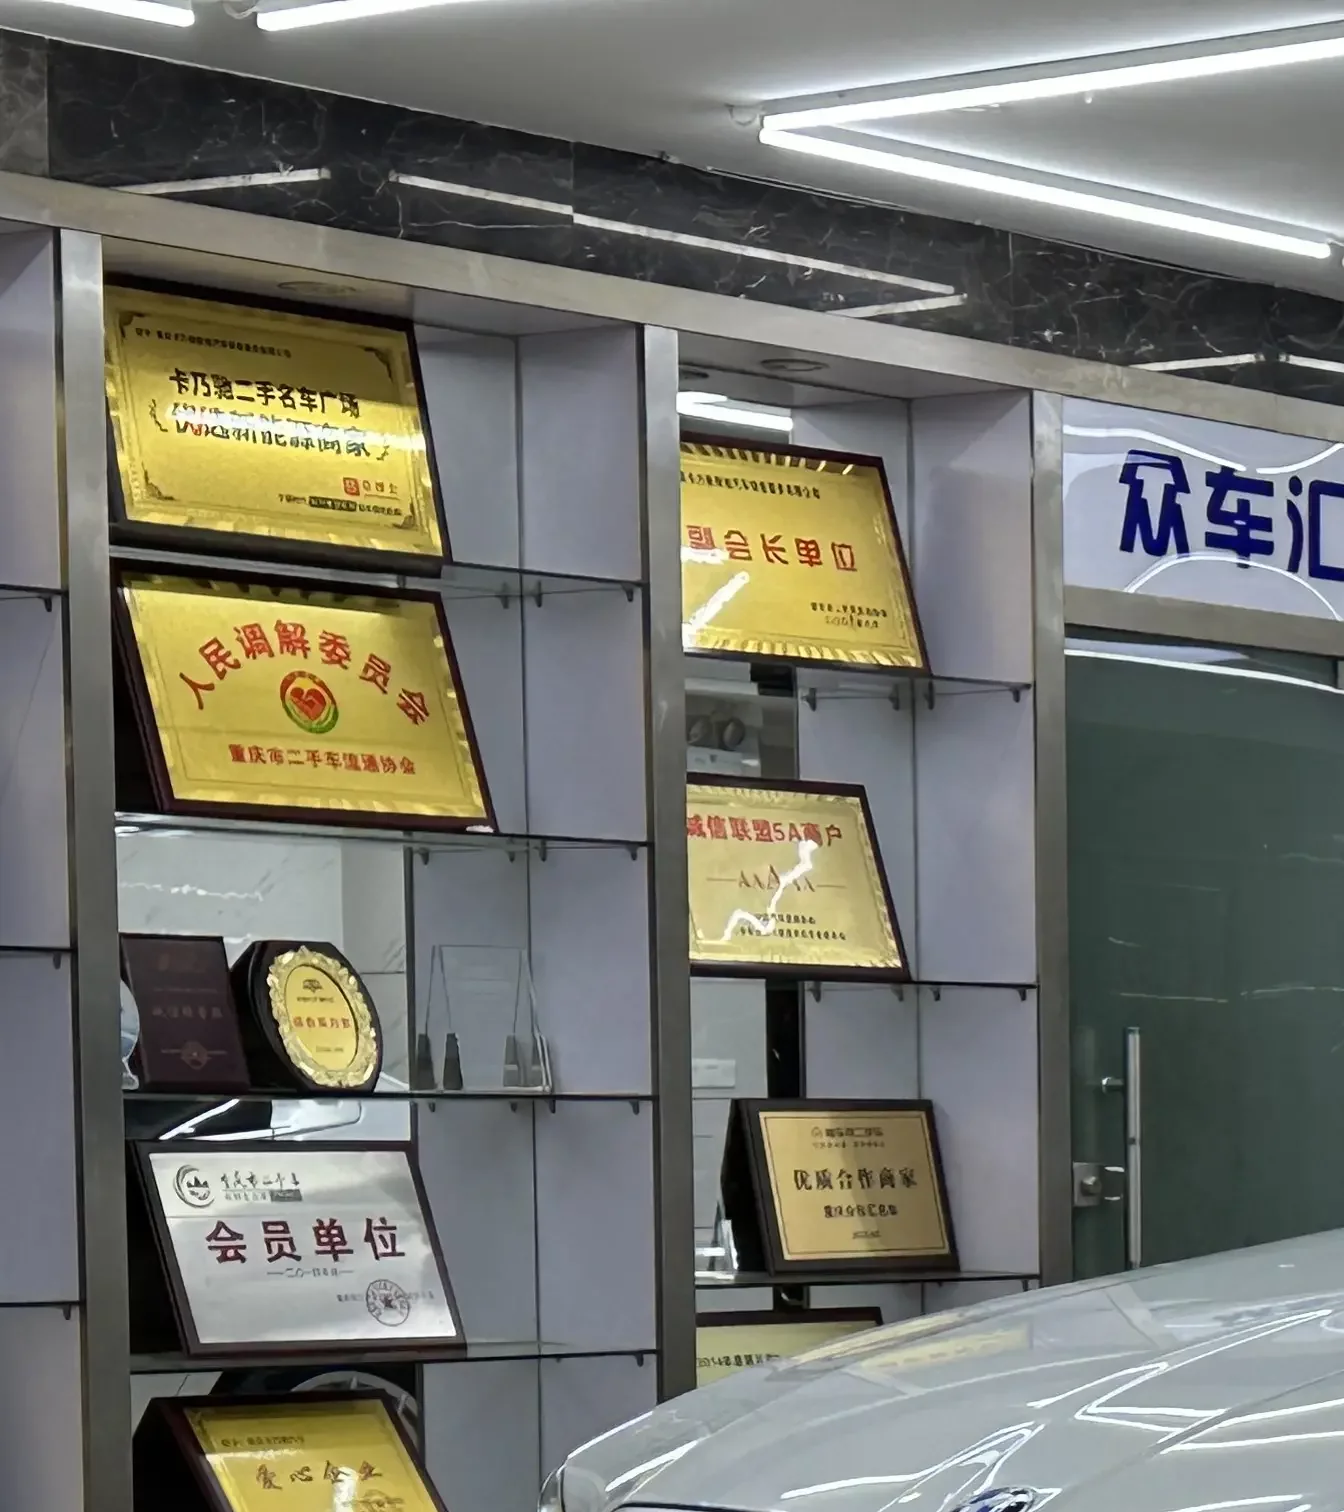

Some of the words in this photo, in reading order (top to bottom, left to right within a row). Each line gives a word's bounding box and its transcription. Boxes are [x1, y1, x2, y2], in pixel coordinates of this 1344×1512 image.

[179, 619, 430, 726] 人民调解委员会
[205, 1217, 406, 1264] 会员单位
